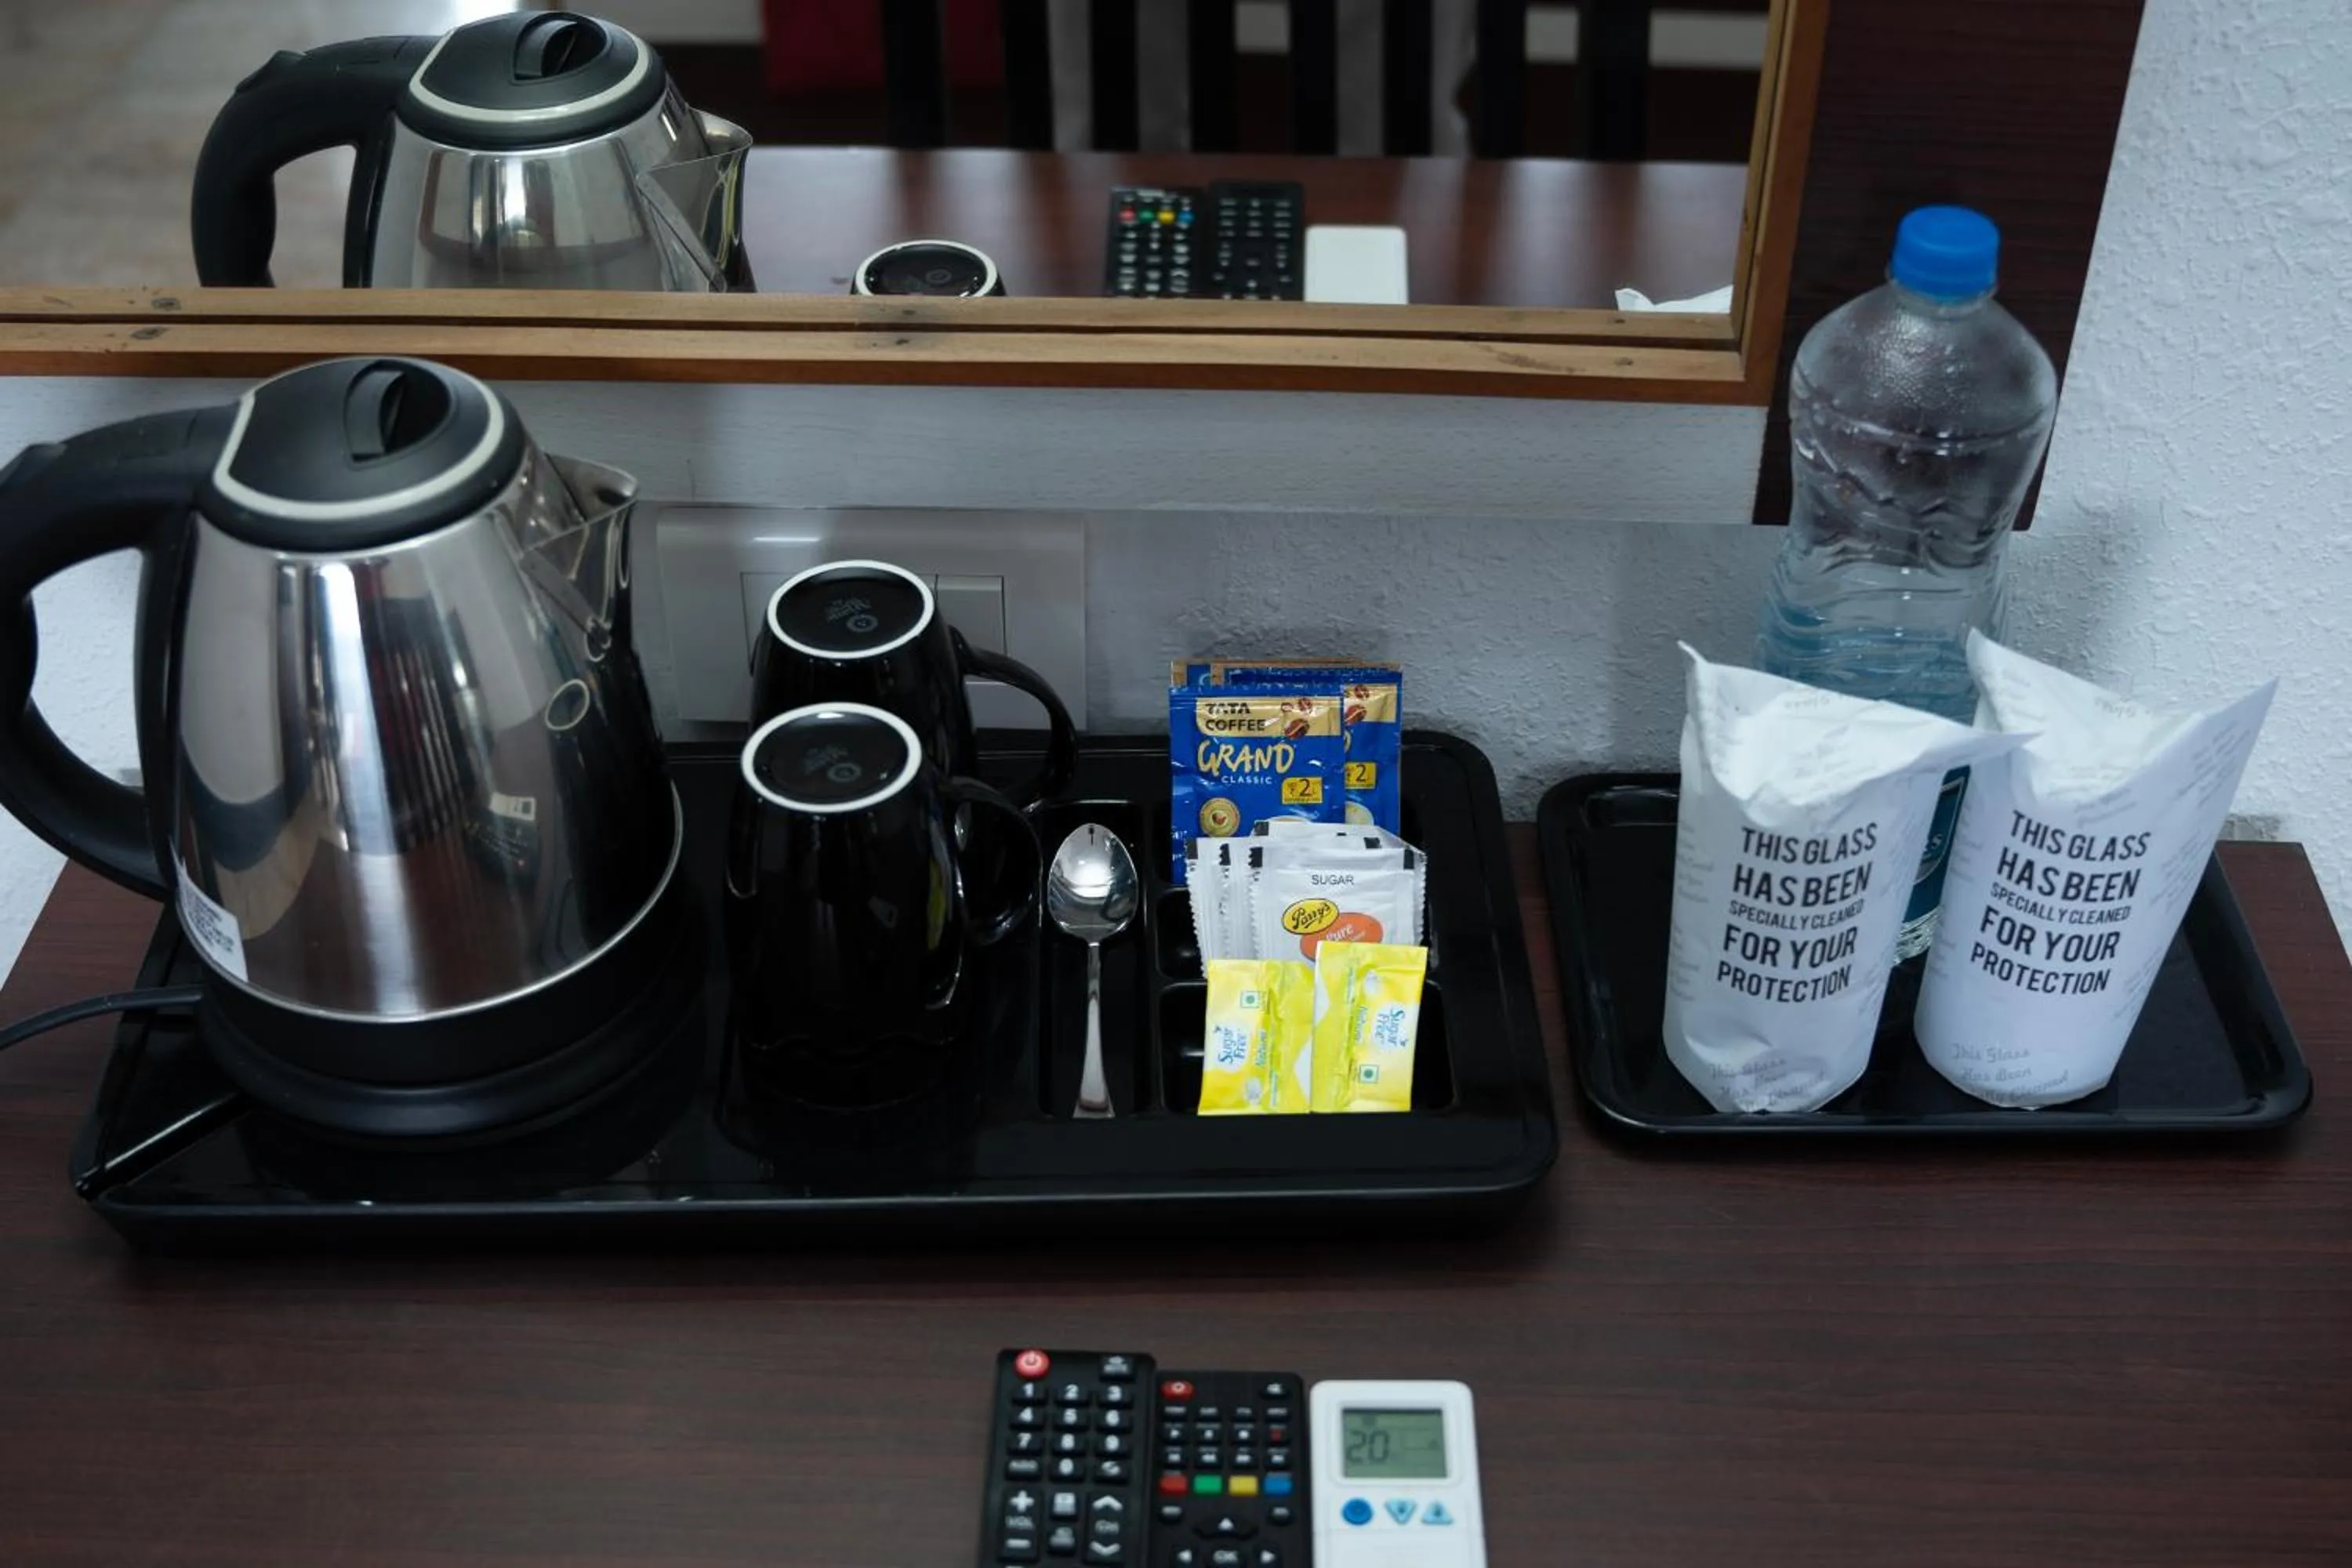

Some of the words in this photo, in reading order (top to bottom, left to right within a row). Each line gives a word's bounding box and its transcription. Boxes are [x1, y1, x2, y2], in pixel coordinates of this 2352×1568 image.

[1205, 718, 1265, 731] COFFEE
[1197, 739, 1294, 777] GRAND
[1221, 775, 1272, 785] CLASSIC
[1741, 826, 1800, 863] THIS
[1802, 822, 1878, 865] GLASS
[2010, 809, 2067, 855] THIS
[2067, 831, 2151, 862] GLASS
[1311, 874, 1355, 886] SUGAR
[1733, 862, 1798, 907] HAS
[1801, 861, 1872, 908] BEEN
[1996, 845, 2060, 897] HAS
[2060, 868, 2141, 903] BEEN
[1729, 899, 1809, 931] SPECIALLY
[1809, 898, 1865, 930] CLEANED
[1990, 881, 2068, 924] SPECIALLY
[2068, 906, 2136, 925] CLEANED
[1722, 923, 1781, 967] FOR
[1790, 926, 1858, 971] YOUR
[1980, 904, 2037, 956] FOR
[2044, 931, 2122, 964] YOUR
[1717, 960, 1853, 1004] PROTECTION
[1969, 942, 2112, 996] PROTECTION
[1065, 1384, 1079, 1399] 2
[1107, 1385, 1122, 1401] 3
[1346, 1428, 1390, 1463] 20
